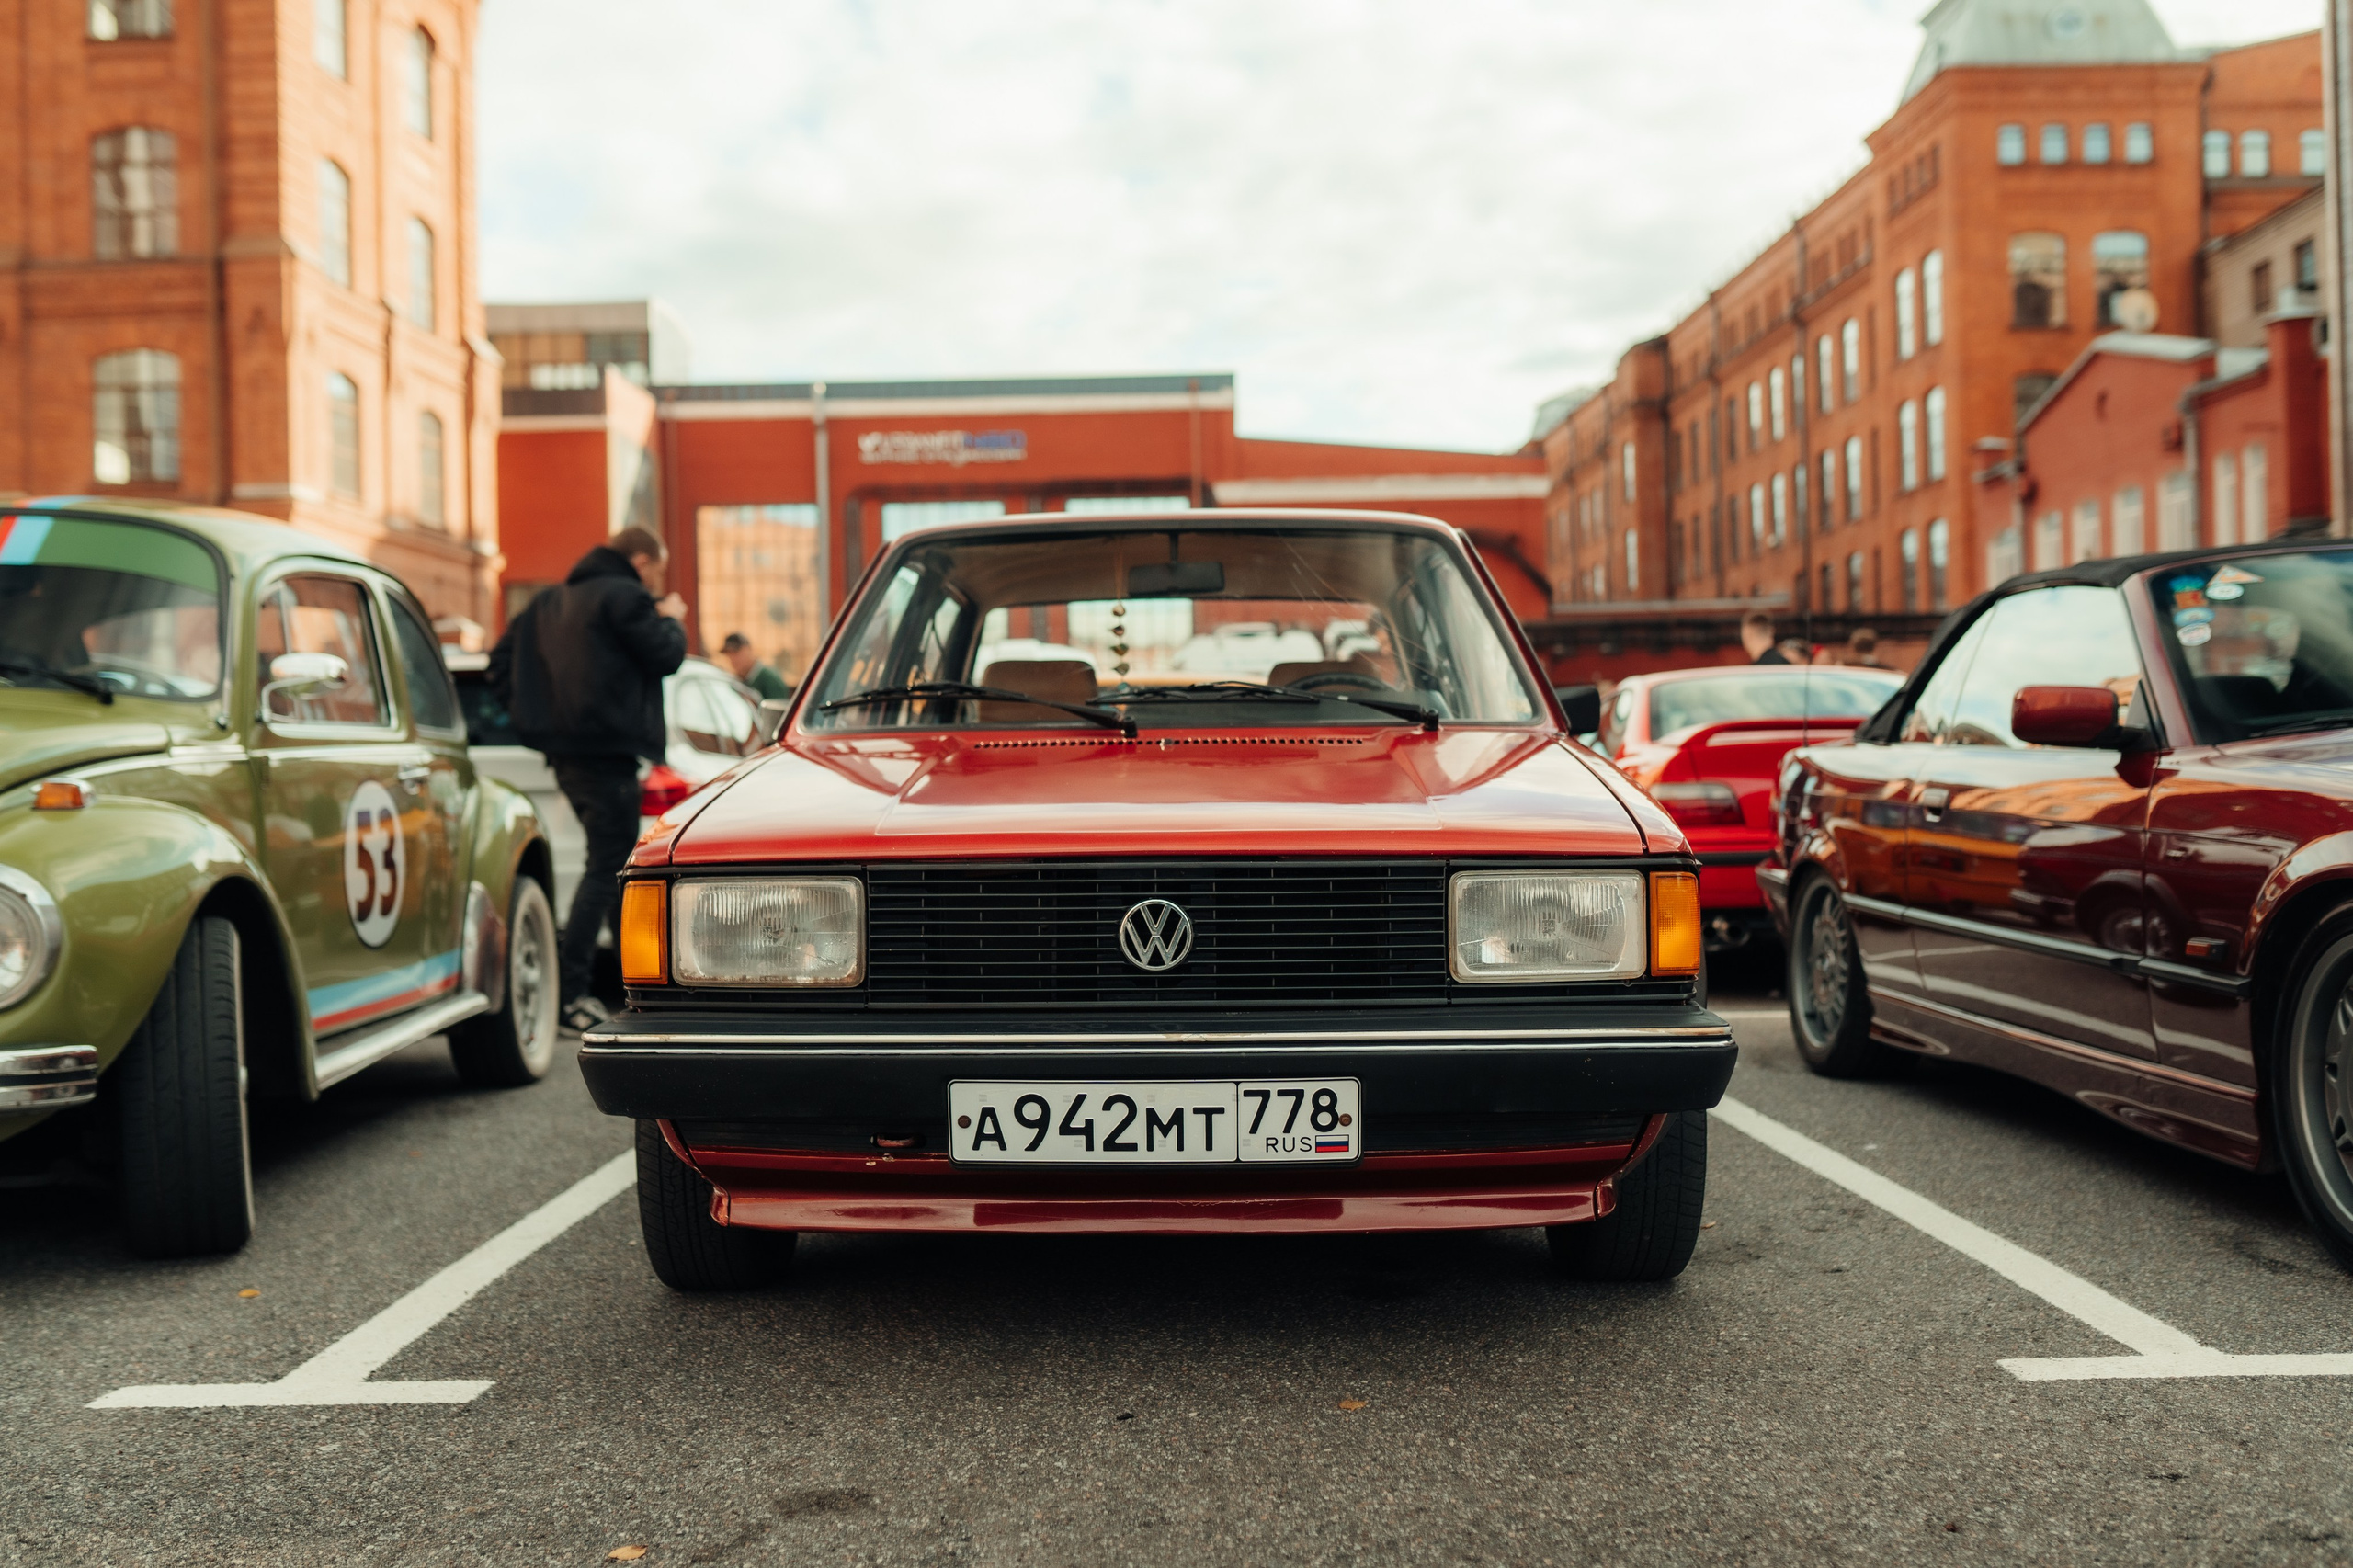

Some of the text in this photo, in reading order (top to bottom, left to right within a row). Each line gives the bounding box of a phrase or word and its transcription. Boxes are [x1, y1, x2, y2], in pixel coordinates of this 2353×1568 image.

[357, 807, 397, 922] 53
[1121, 900, 1192, 971] VW
[1243, 1087, 1339, 1135] 778
[1265, 1136, 1313, 1153] RUS
